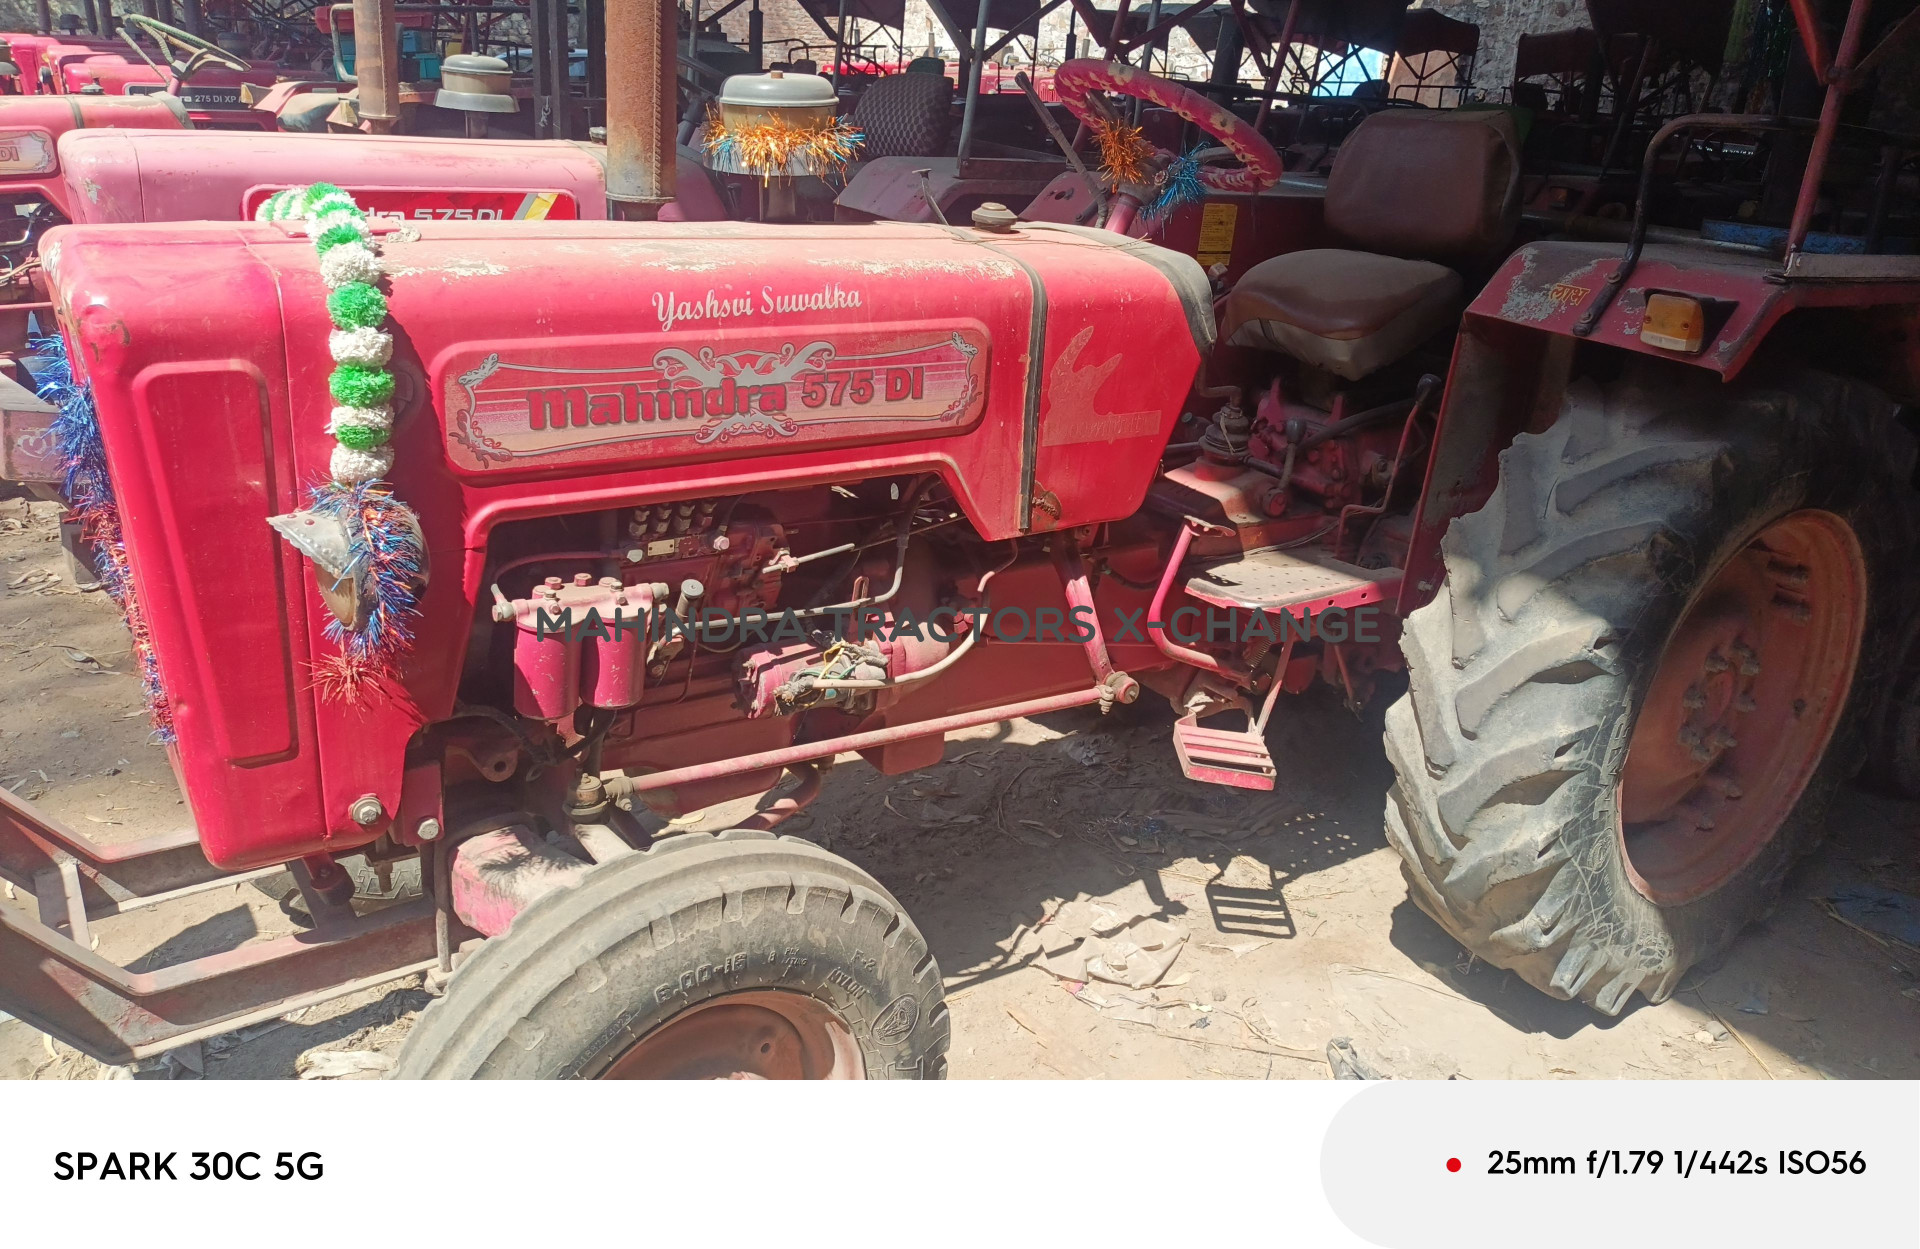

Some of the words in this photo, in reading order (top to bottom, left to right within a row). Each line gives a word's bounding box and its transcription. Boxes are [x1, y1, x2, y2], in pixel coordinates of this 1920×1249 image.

[195, 94, 211, 103] 275
[213, 95, 222, 103] DI
[224, 95, 237, 103] XP
[651, 289, 754, 332] Yashsvi
[760, 282, 863, 315] Suwalka
[1550, 283, 1591, 306] लाभ
[526, 378, 788, 431] Mahindra
[801, 369, 875, 408] 575
[884, 367, 924, 402] DI
[654, 952, 748, 1004] 6.00-16
[826, 968, 867, 1000] NYLON
